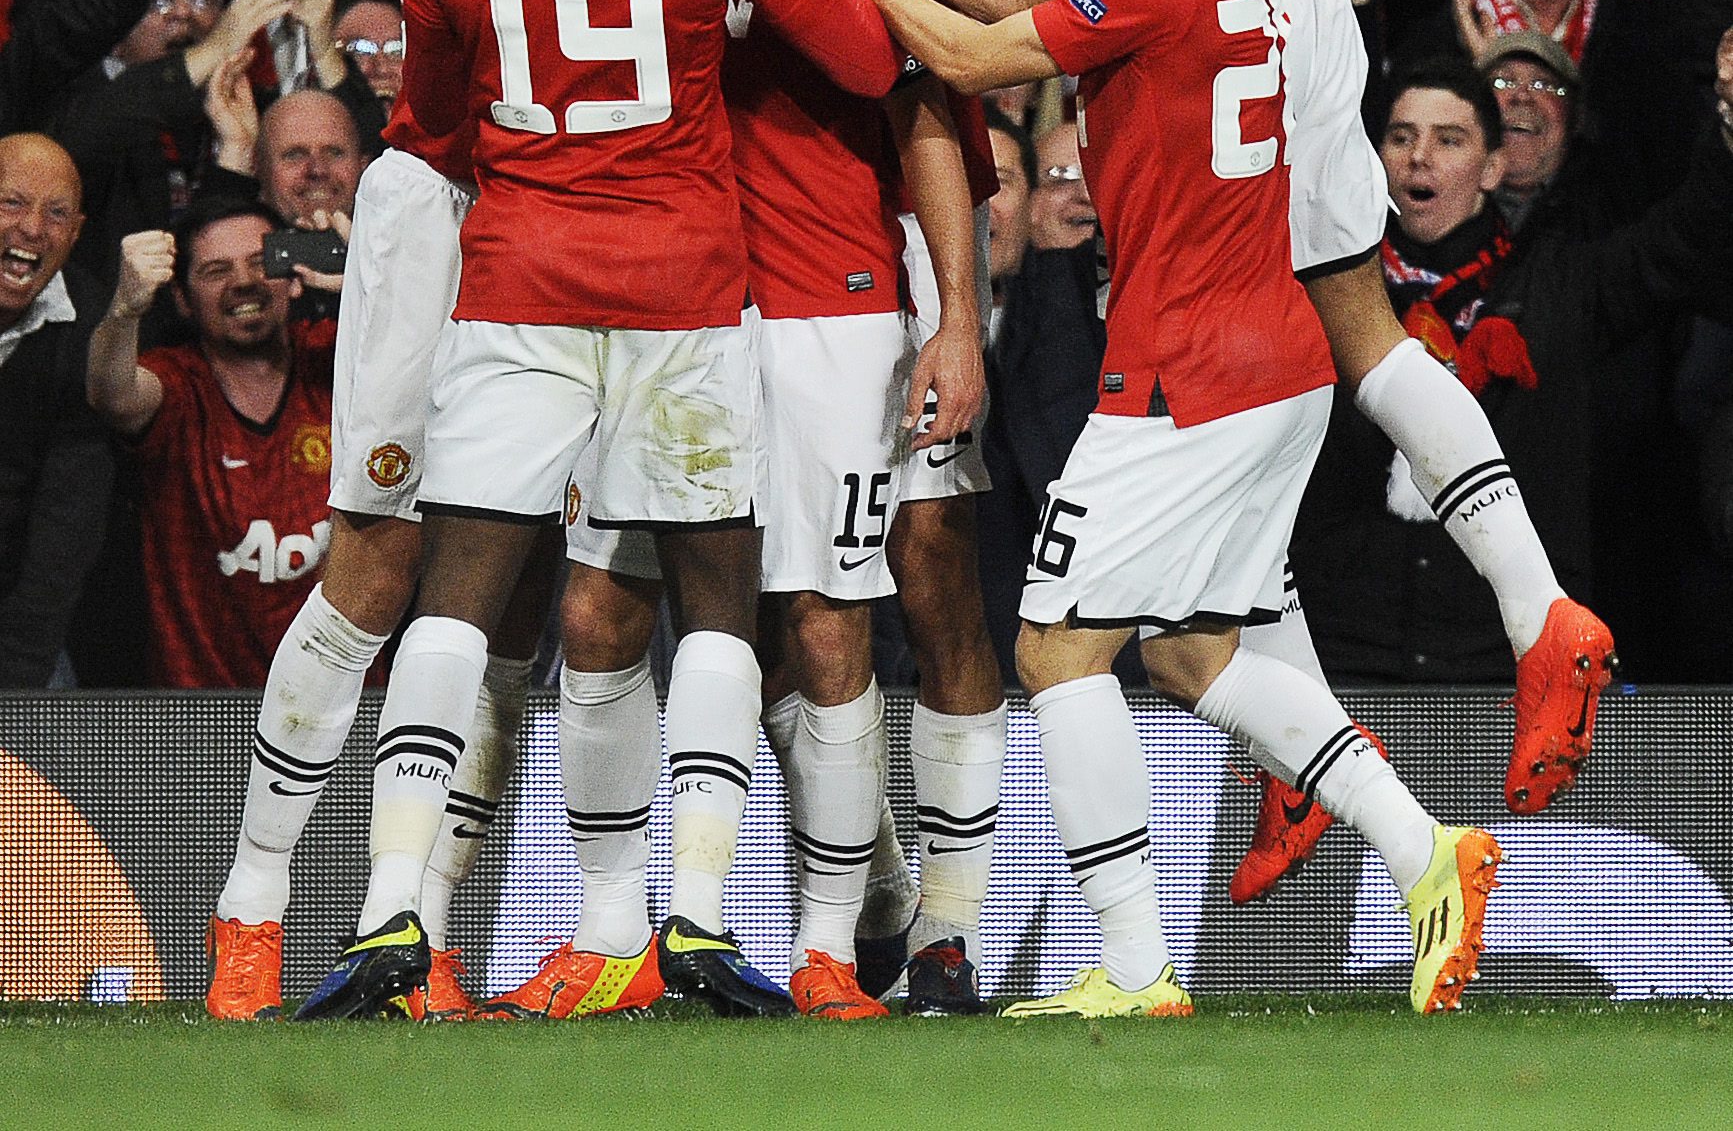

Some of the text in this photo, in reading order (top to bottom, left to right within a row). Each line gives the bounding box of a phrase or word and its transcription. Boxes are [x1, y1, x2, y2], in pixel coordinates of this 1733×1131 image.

[833, 472, 892, 549] 15
[1460, 484, 1519, 523] MUFC
[395, 762, 452, 790] MUFC
[672, 780, 713, 797] UFC
